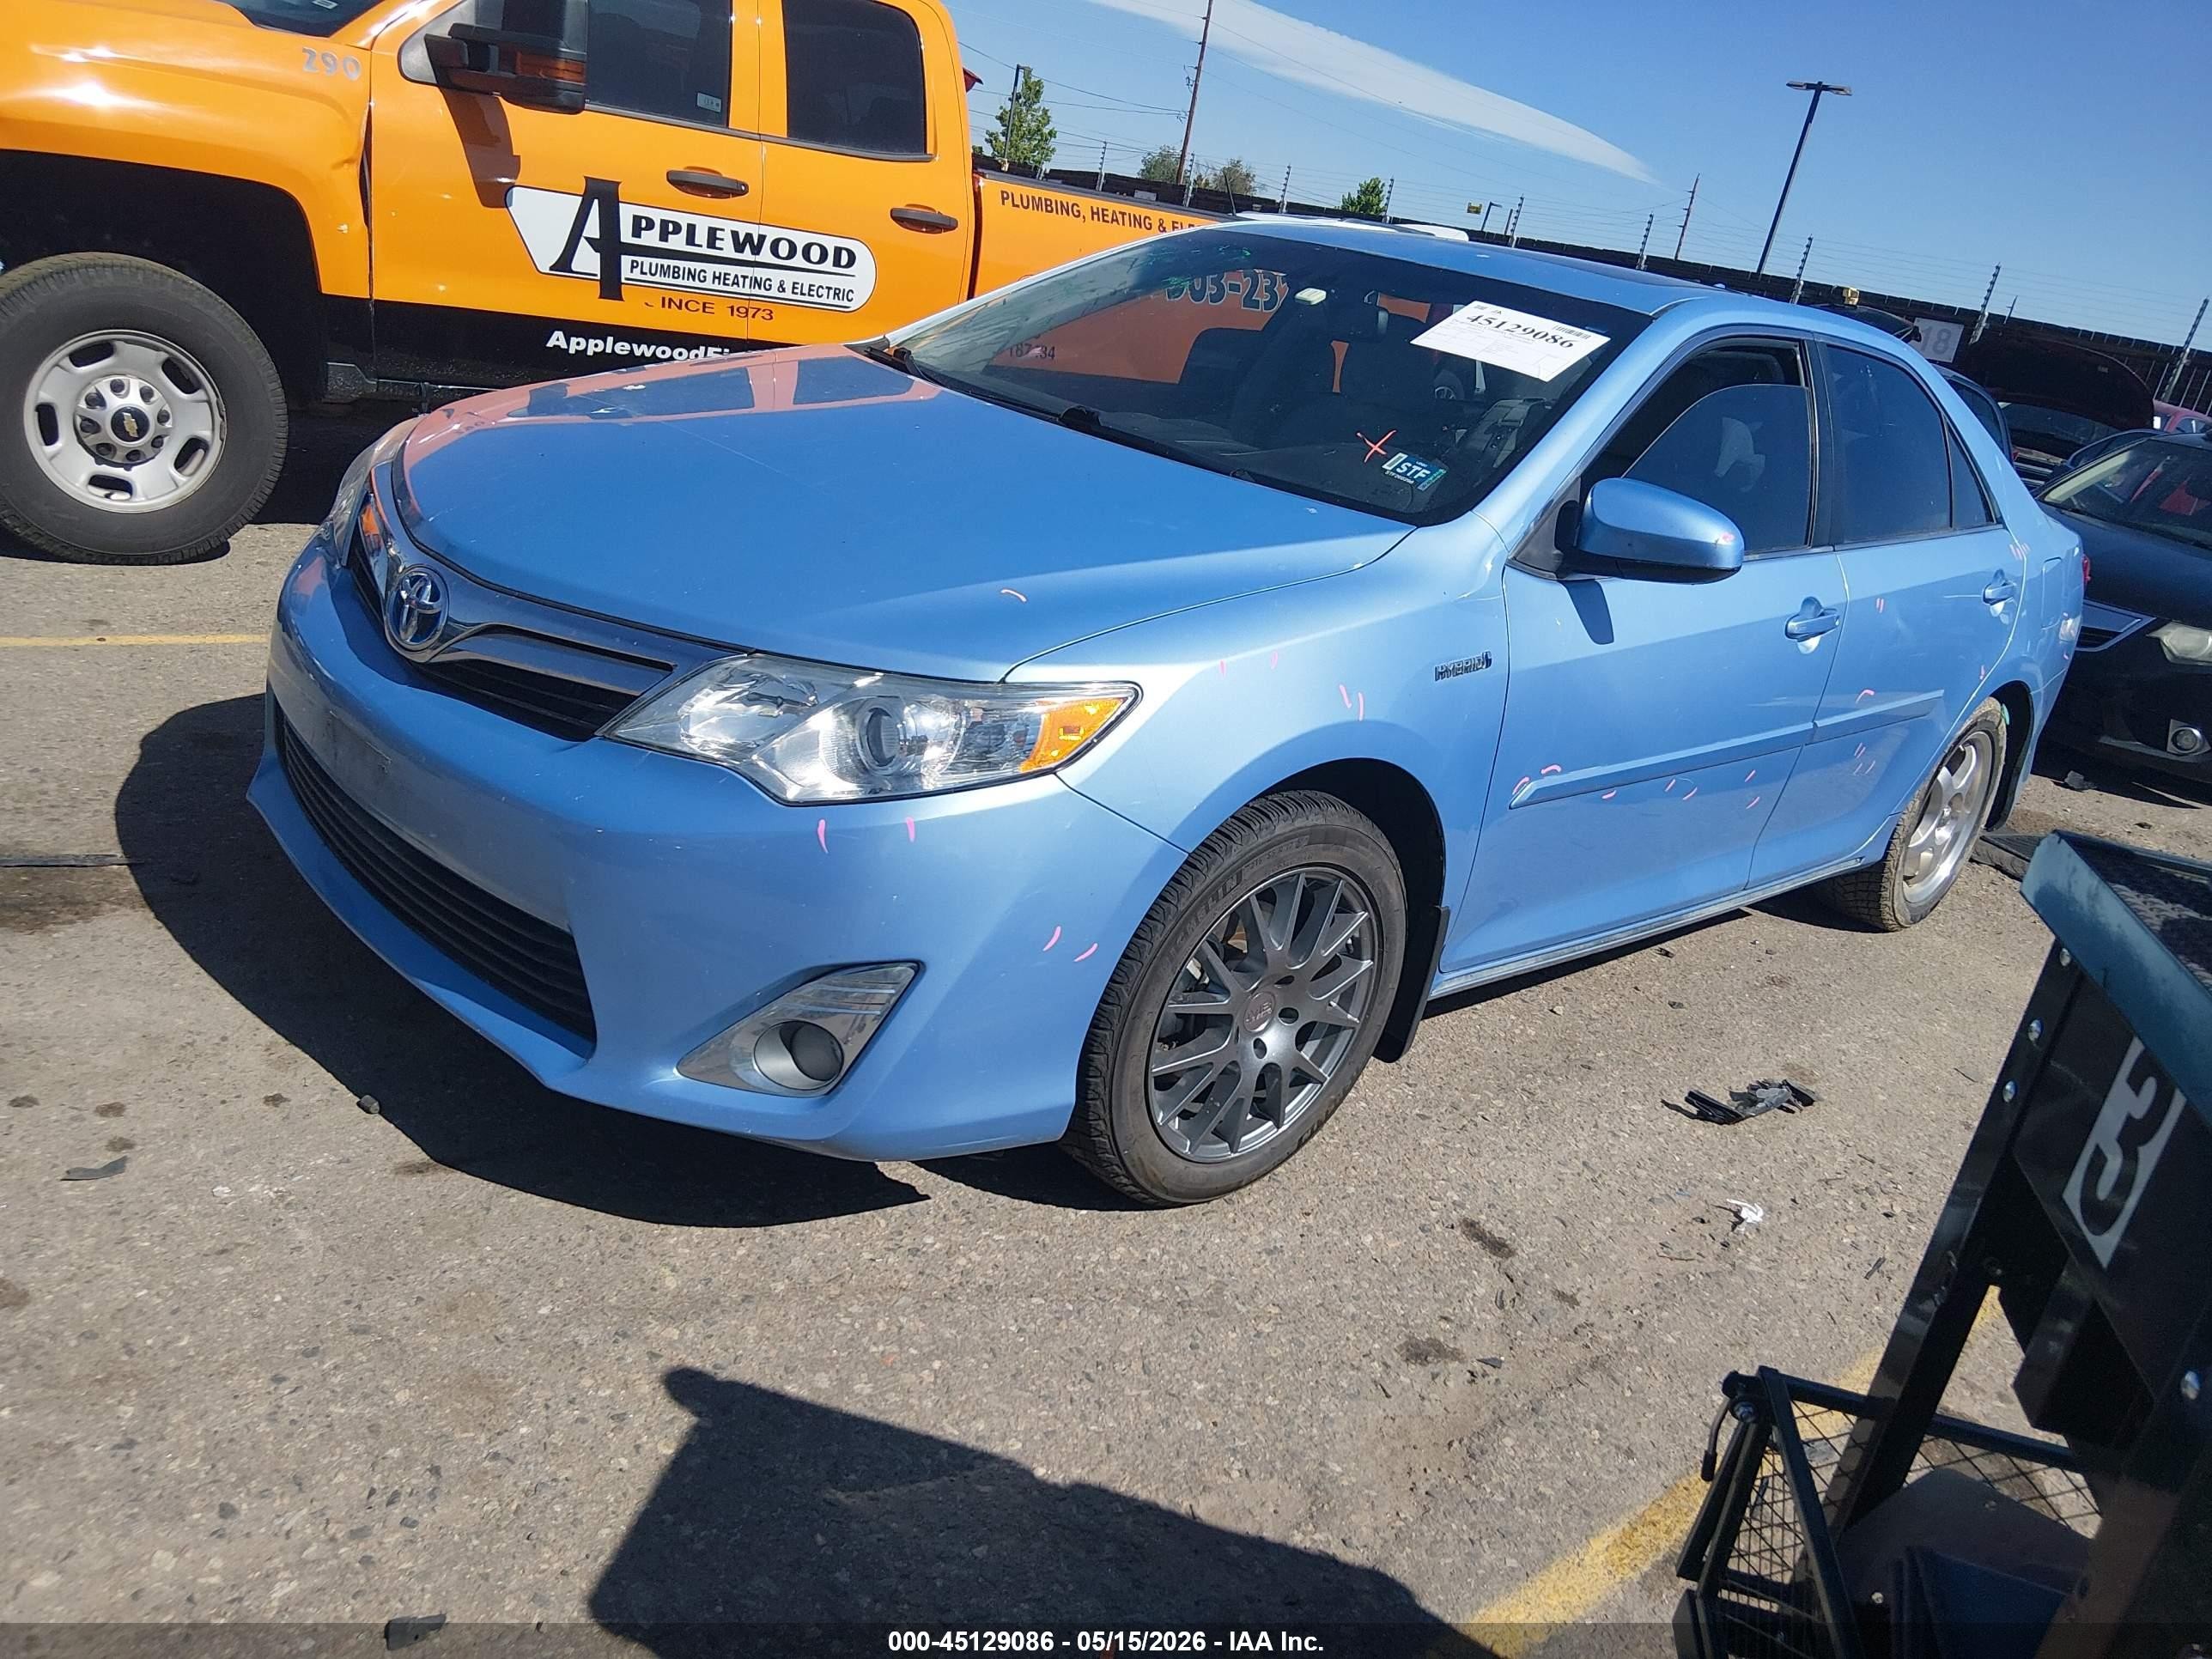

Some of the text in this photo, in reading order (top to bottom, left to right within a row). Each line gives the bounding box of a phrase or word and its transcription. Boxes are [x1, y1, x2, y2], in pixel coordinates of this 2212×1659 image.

[302, 46, 362, 82] 290
[1000, 190, 1086, 222] PLUMBING,
[1091, 206, 1152, 231] HEATING
[1158, 218, 1167, 233] &
[629, 259, 854, 302] PLUMBING HEATING & ELECTRIC
[726, 305, 774, 321] 1973
[1467, 314, 1575, 349] 45129086
[1396, 462, 1431, 479] STF
[1434, 655, 1484, 682] HYBRID
